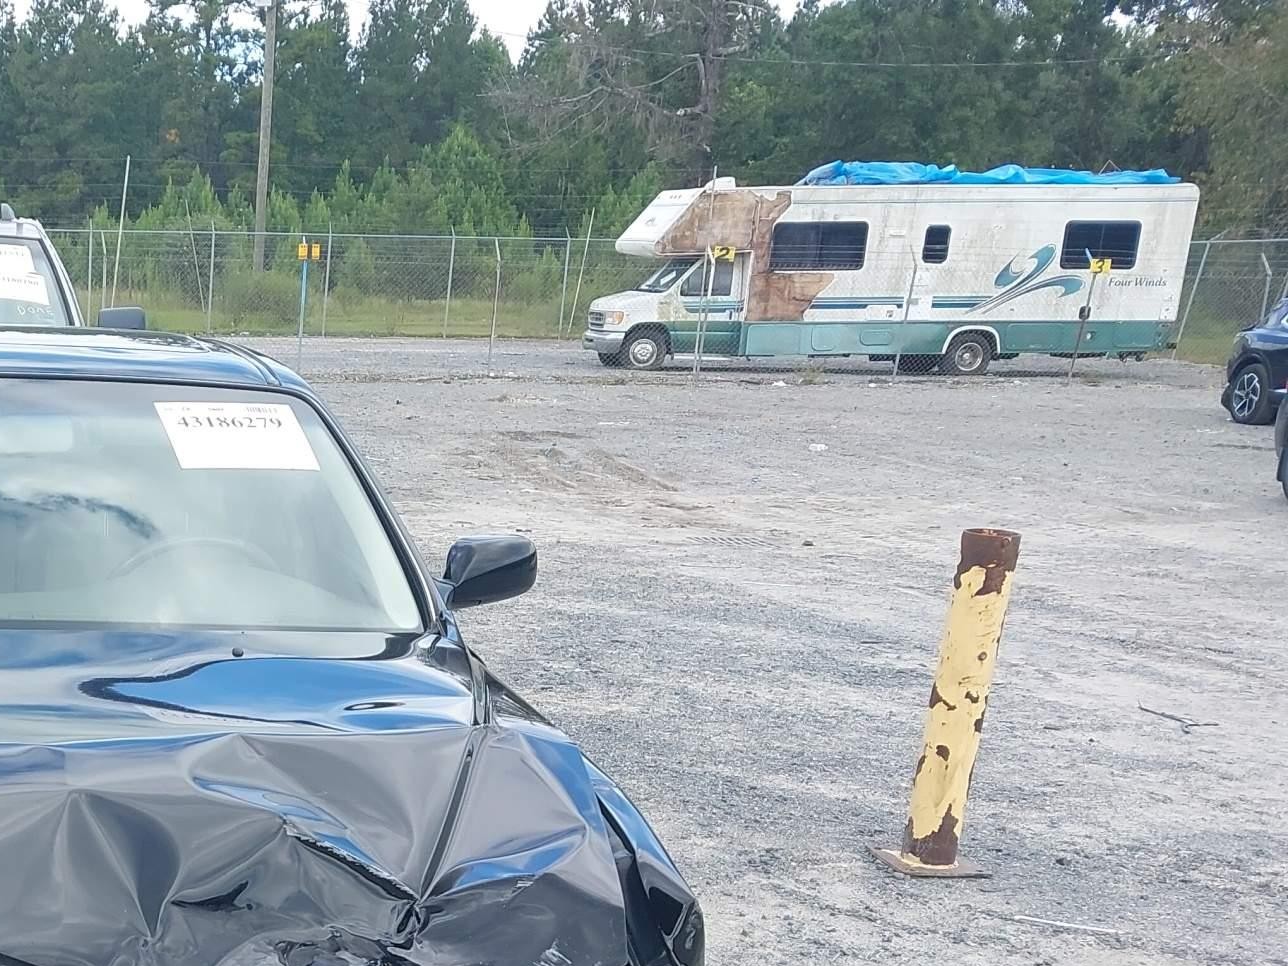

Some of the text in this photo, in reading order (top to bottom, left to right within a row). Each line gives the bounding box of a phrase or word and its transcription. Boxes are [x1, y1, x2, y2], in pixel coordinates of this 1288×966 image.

[717, 247, 730, 258] 2
[1095, 260, 1105, 274] 3
[1108, 277, 1167, 288] Four Winds
[177, 415, 283, 429] 43186279
